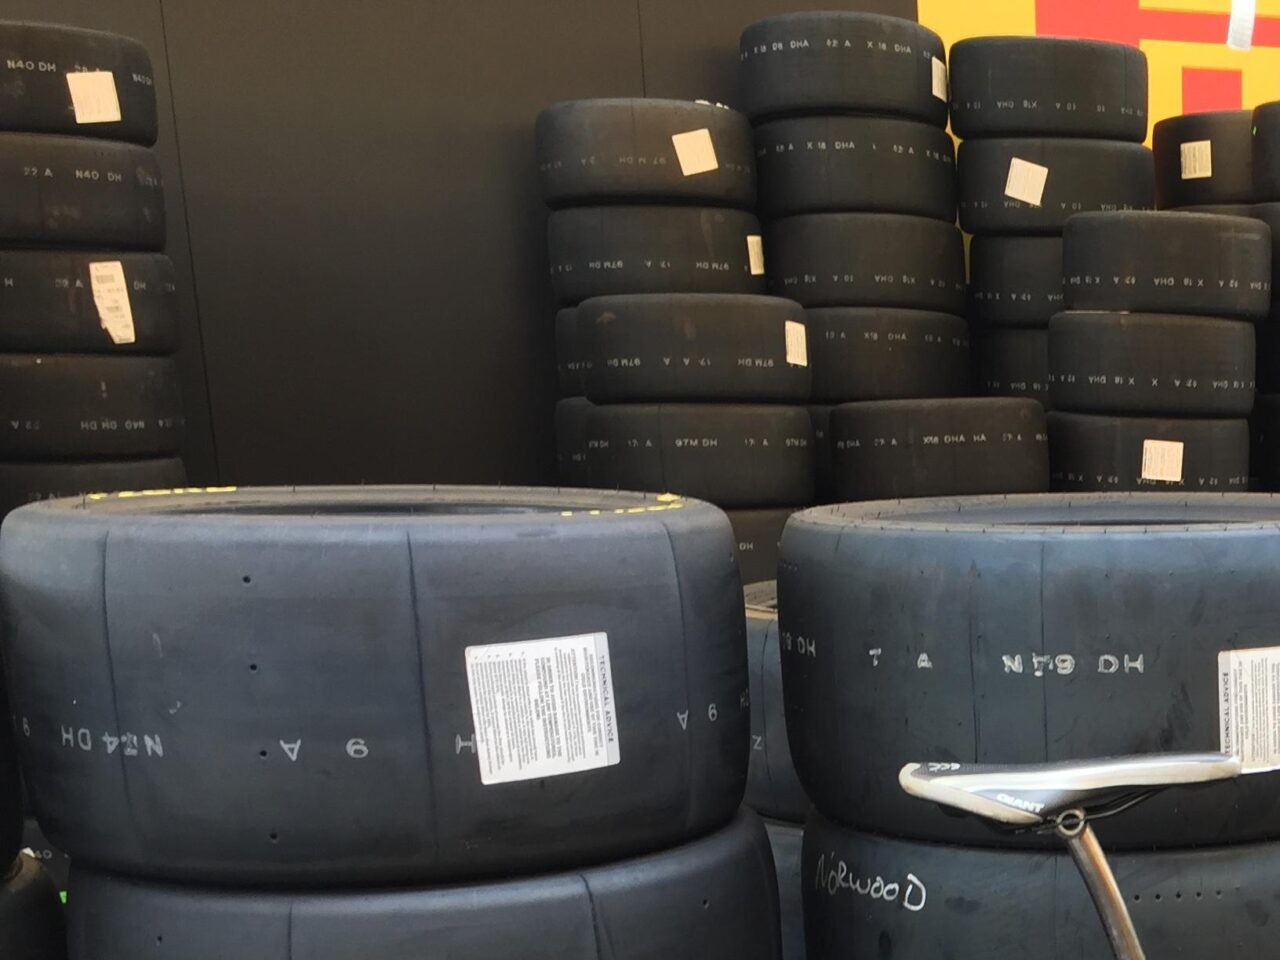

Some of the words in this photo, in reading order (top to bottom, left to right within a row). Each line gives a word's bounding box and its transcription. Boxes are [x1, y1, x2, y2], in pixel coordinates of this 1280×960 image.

[1097, 653, 1145, 674] DH
[598, 655, 610, 706] TECHNICAL
[604, 710, 614, 743] ADVICE
[676, 709, 690, 731] A
[61, 728, 93, 751] DH
[280, 738, 302, 762] A
[345, 738, 369, 761] 9
[995, 791, 1046, 813] GIANT
